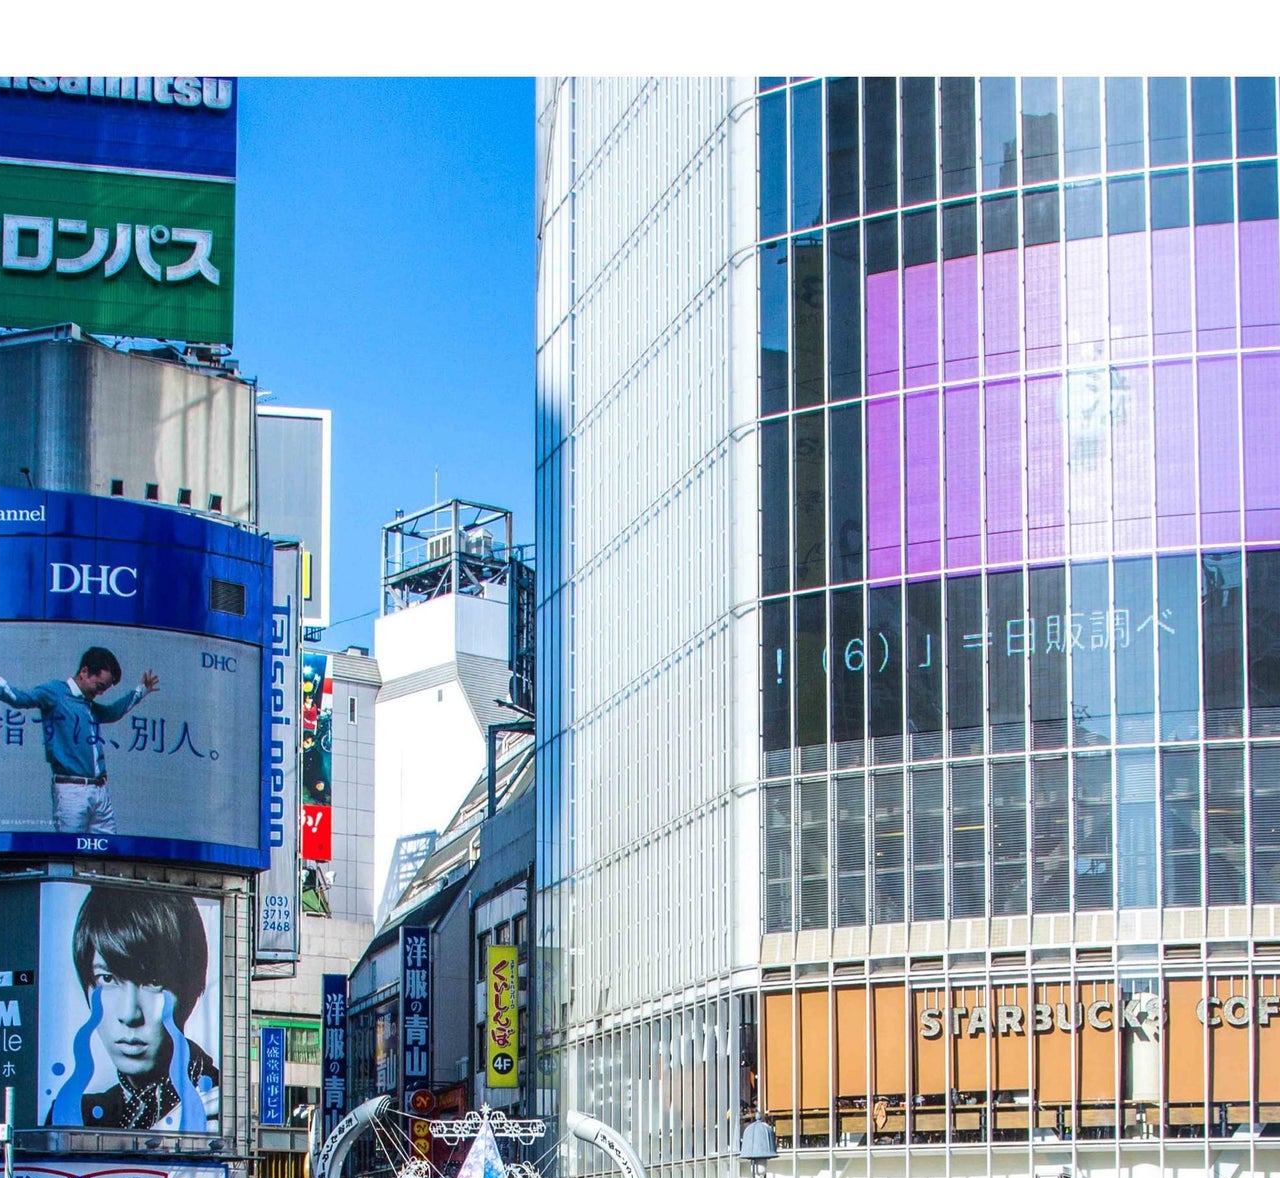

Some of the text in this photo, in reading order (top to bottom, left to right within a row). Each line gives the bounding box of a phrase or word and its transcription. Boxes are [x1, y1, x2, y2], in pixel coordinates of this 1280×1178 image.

[50, 562, 138, 598] DHC
[201, 652, 237, 674] DHC
[77, 838, 108, 851] DHC
[265, 896, 289, 908] (03)
[263, 909, 291, 921] 3719
[262, 921, 291, 933] 2468
[405, 935, 430, 1076] 洋服の青山
[920, 992, 1168, 1040] STARBUCKS
[494, 1057, 512, 1071] 4F
[267, 1033, 281, 1119] 大盛堂商事ビル
